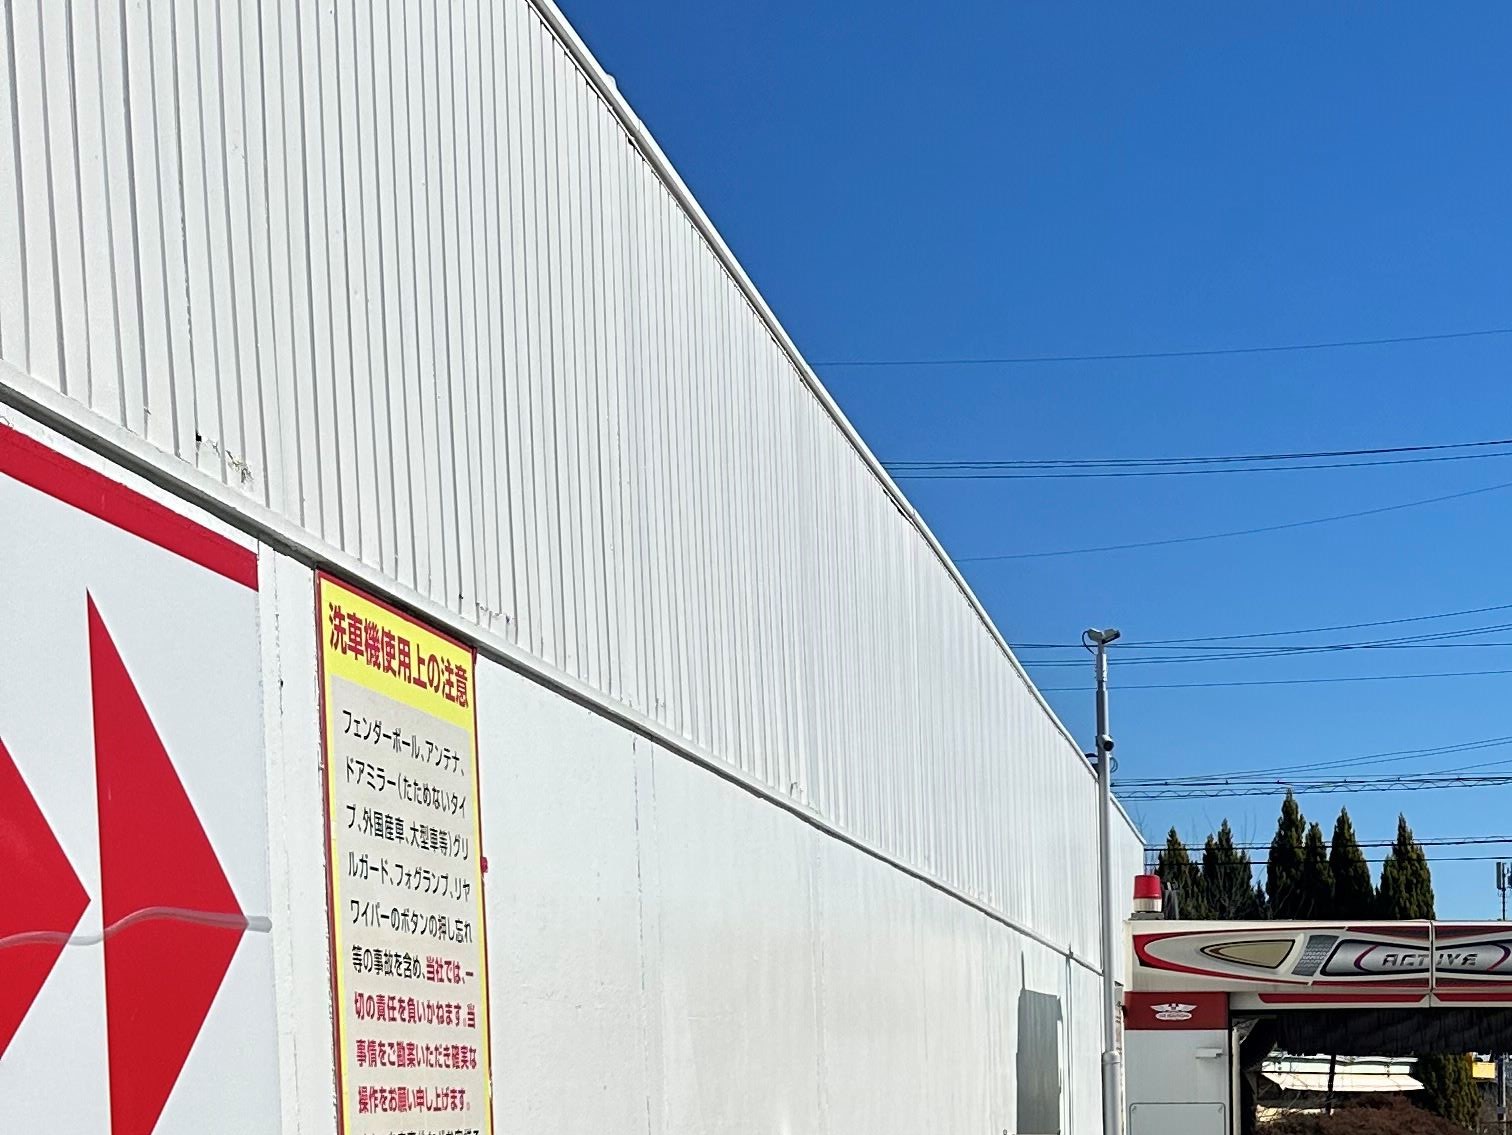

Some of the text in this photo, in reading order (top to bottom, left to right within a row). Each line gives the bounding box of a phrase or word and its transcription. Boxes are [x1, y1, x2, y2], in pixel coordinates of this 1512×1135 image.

[328, 601, 470, 708] 洗車機使用上の注意
[342, 709, 465, 776] フェンダーポール、アンテナ、
[348, 851, 471, 902] ルガード、フォグランプ、リヤ
[350, 899, 473, 944] ワイパーのボタンの押し忘れ
[1382, 953, 1478, 967] ACTIVE
[355, 1039, 478, 1070] 事情をご勘案いただき確実な
[358, 1085, 471, 1114] 操作をお願い申し上げます。
